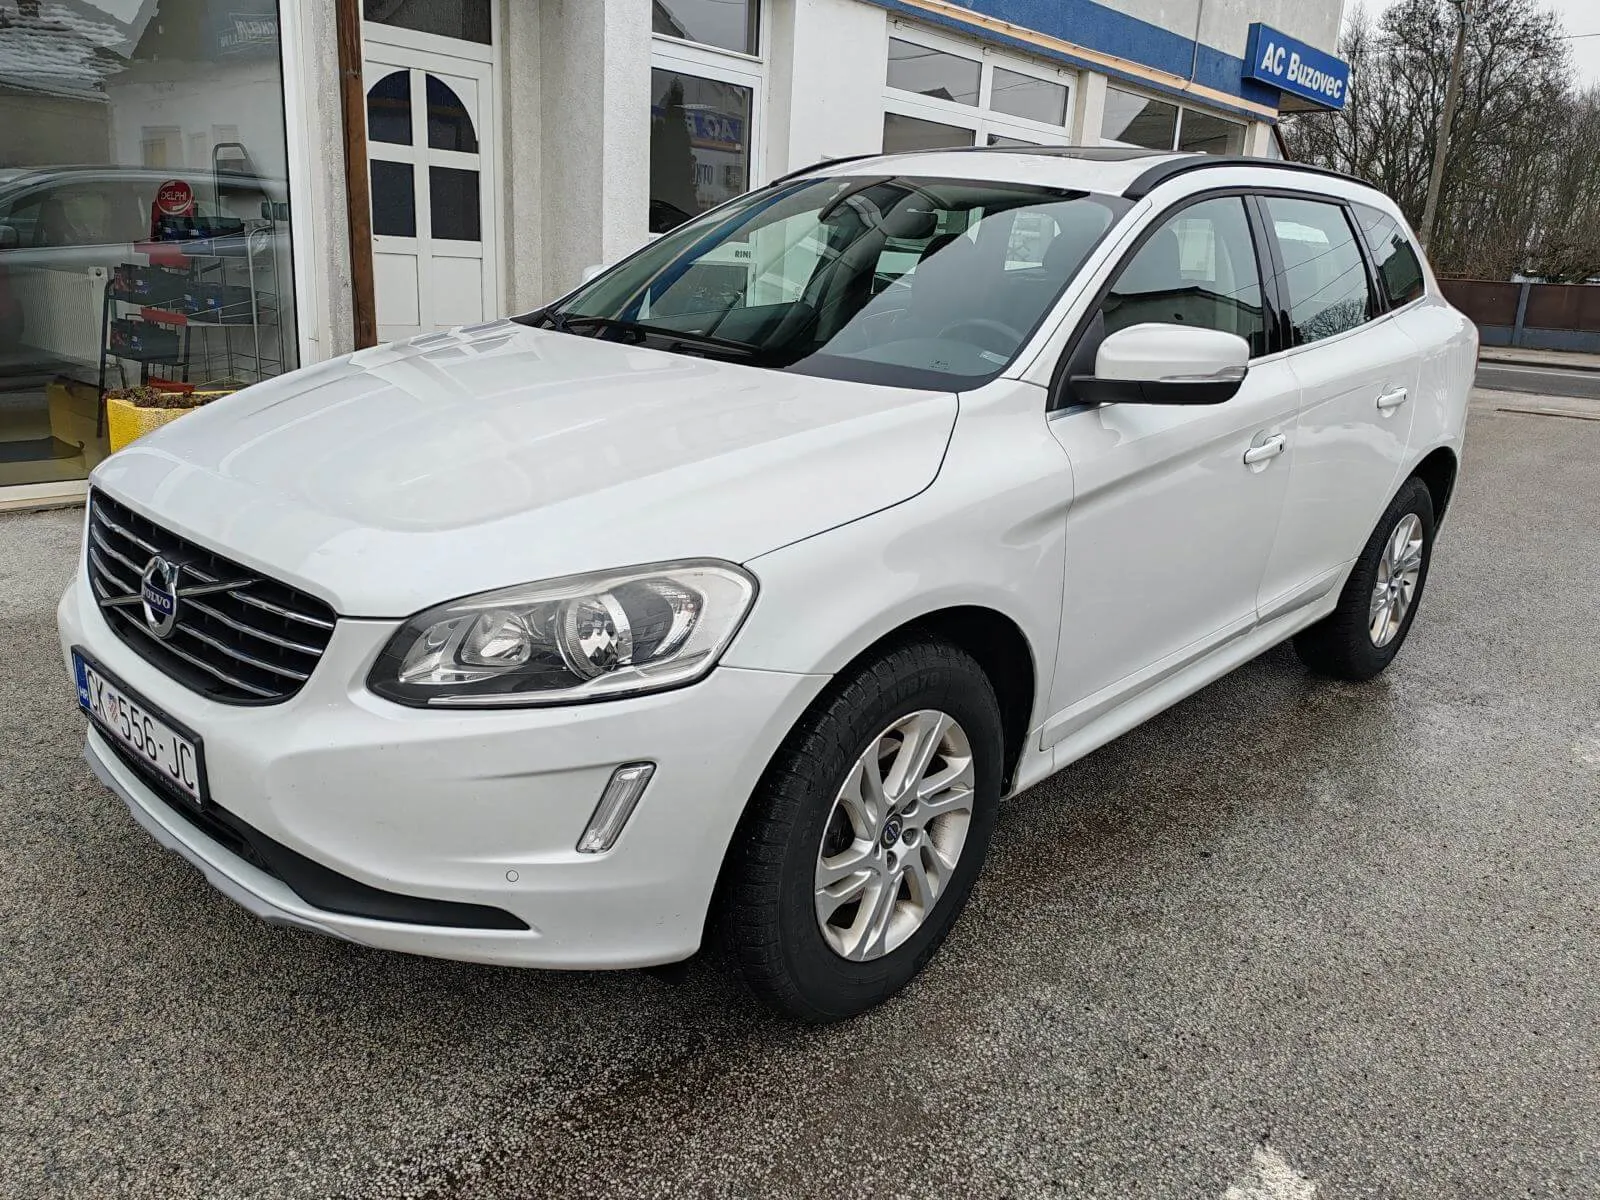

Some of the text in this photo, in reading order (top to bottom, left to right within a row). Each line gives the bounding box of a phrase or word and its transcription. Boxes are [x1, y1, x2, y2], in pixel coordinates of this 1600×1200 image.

[1260, 42, 1343, 99] AC Buzovec
[160, 191, 187, 201] DELPHI
[86, 669, 109, 723] CK
[117, 695, 194, 790] 556-JC
